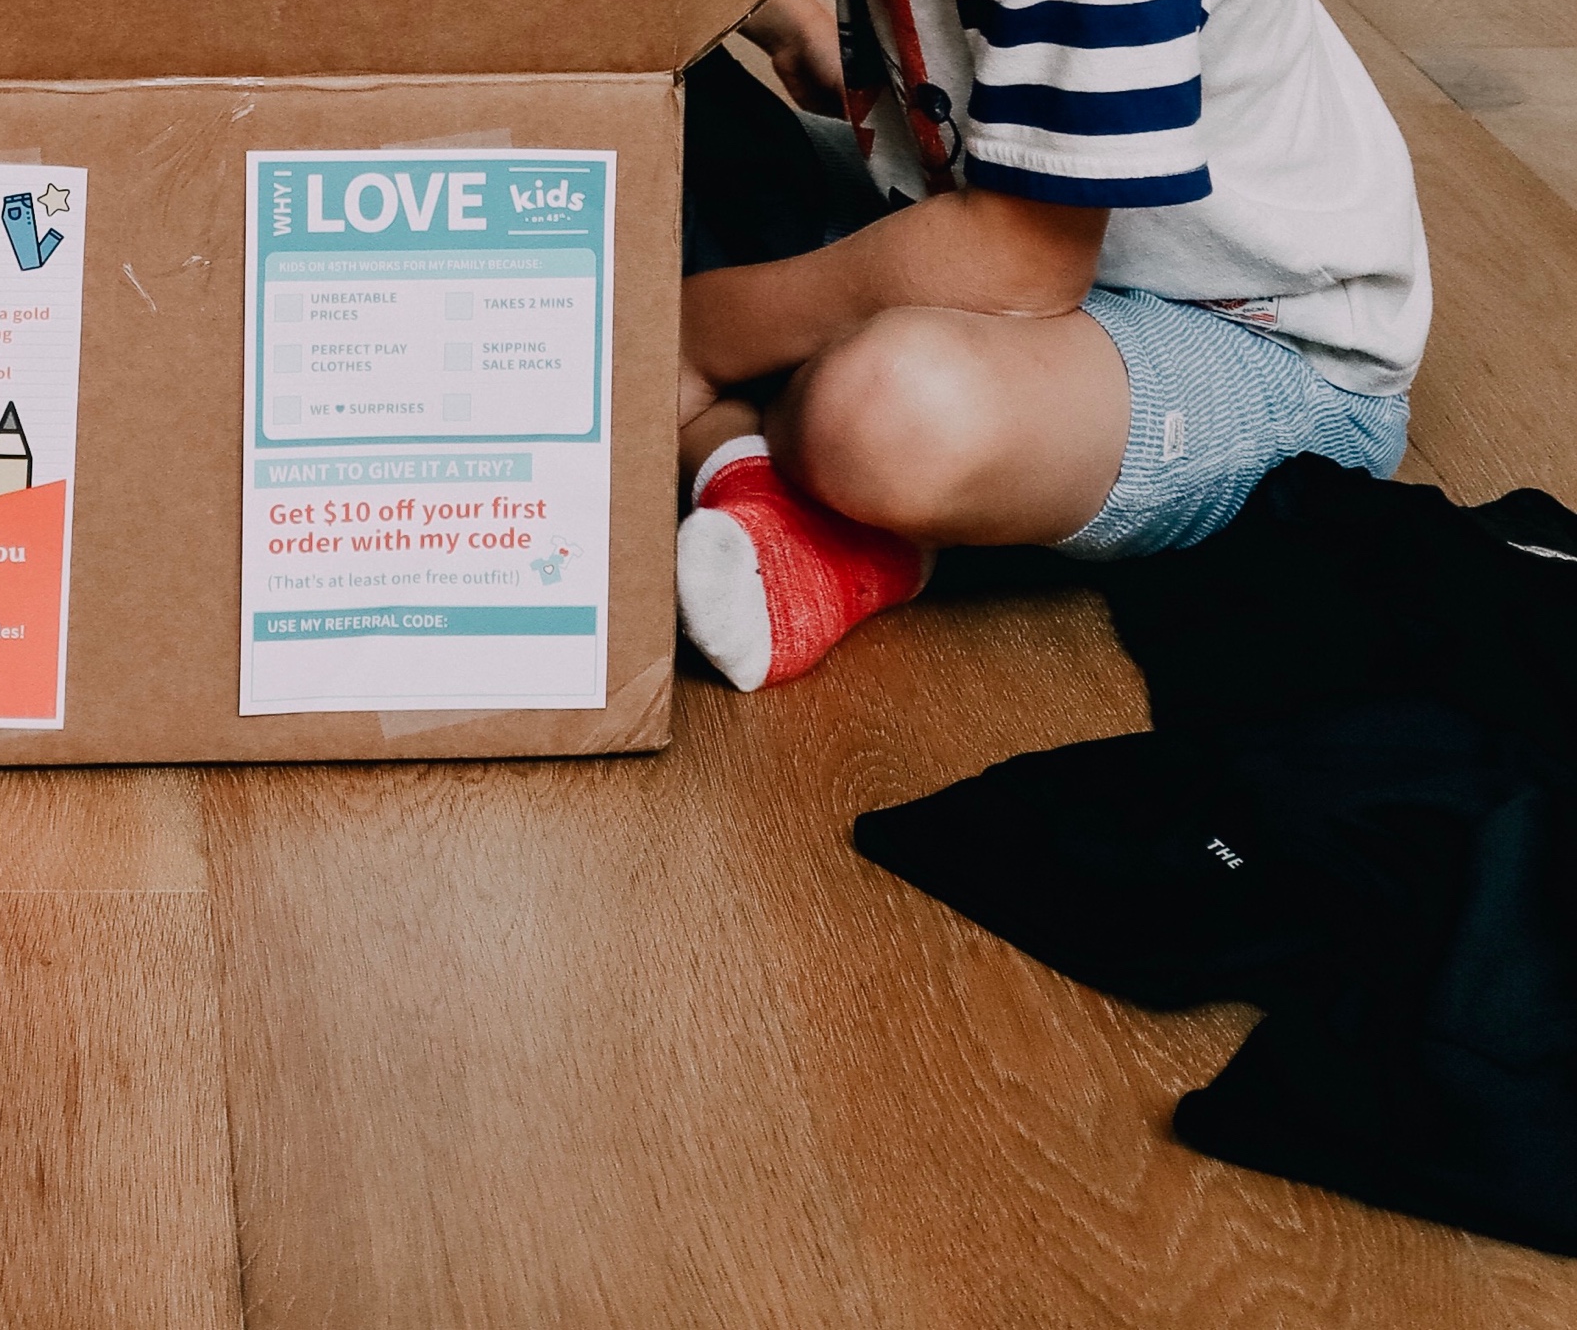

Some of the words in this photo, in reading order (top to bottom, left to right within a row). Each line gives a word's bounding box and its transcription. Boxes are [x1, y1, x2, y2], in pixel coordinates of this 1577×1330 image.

[306, 171, 488, 234] LOVE
[509, 179, 586, 213] kids
[273, 182, 292, 237] WHY
[279, 260, 306, 273] KIDS
[308, 260, 325, 272] ON
[327, 260, 357, 272] 45TH
[359, 259, 401, 272] WORKS
[403, 259, 426, 271] FOR
[428, 259, 445, 271] MY
[447, 258, 486, 271] FAMILY
[488, 257, 543, 270] BECAUSE:
[310, 292, 397, 305] UNBEATABLE
[483, 298, 525, 310] TAKES
[528, 297, 536, 309] 2
[540, 297, 574, 309] MINS
[0, 309, 8, 320] a
[13, 307, 50, 324] gold
[310, 309, 358, 321] PRICES
[311, 344, 370, 356] PERFECT
[374, 343, 408, 355] PLAY
[482, 341, 547, 354] SKIPPING
[310, 360, 372, 373] CLOTHES
[482, 359, 515, 371] SALE
[518, 358, 562, 370] RACKS
[310, 404, 330, 416] WE
[349, 402, 425, 415] SURPRISES
[269, 464, 329, 483] WANT
[336, 463, 363, 480] TO
[368, 461, 416, 479] GIVE
[421, 460, 441, 478] IT
[445, 460, 460, 477] A
[464, 459, 514, 477] TRY?
[269, 503, 315, 526] Get
[324, 499, 371, 527] $10
[378, 498, 416, 522] off
[422, 500, 484, 526] your
[491, 496, 547, 520] first
[268, 532, 344, 555] order
[351, 529, 411, 553] with
[419, 531, 461, 555] my
[467, 527, 532, 550] code
[267, 573, 324, 593] (That's
[328, 575, 345, 588] at
[348, 572, 387, 587] least
[391, 573, 422, 586] one
[425, 570, 458, 585] free
[462, 568, 520, 588] outfit!)
[267, 619, 297, 633] USE
[300, 619, 322, 632] MY
[325, 614, 400, 631] REFERRAL
[402, 614, 448, 628] CODE:
[1207, 838, 1244, 870] THE
